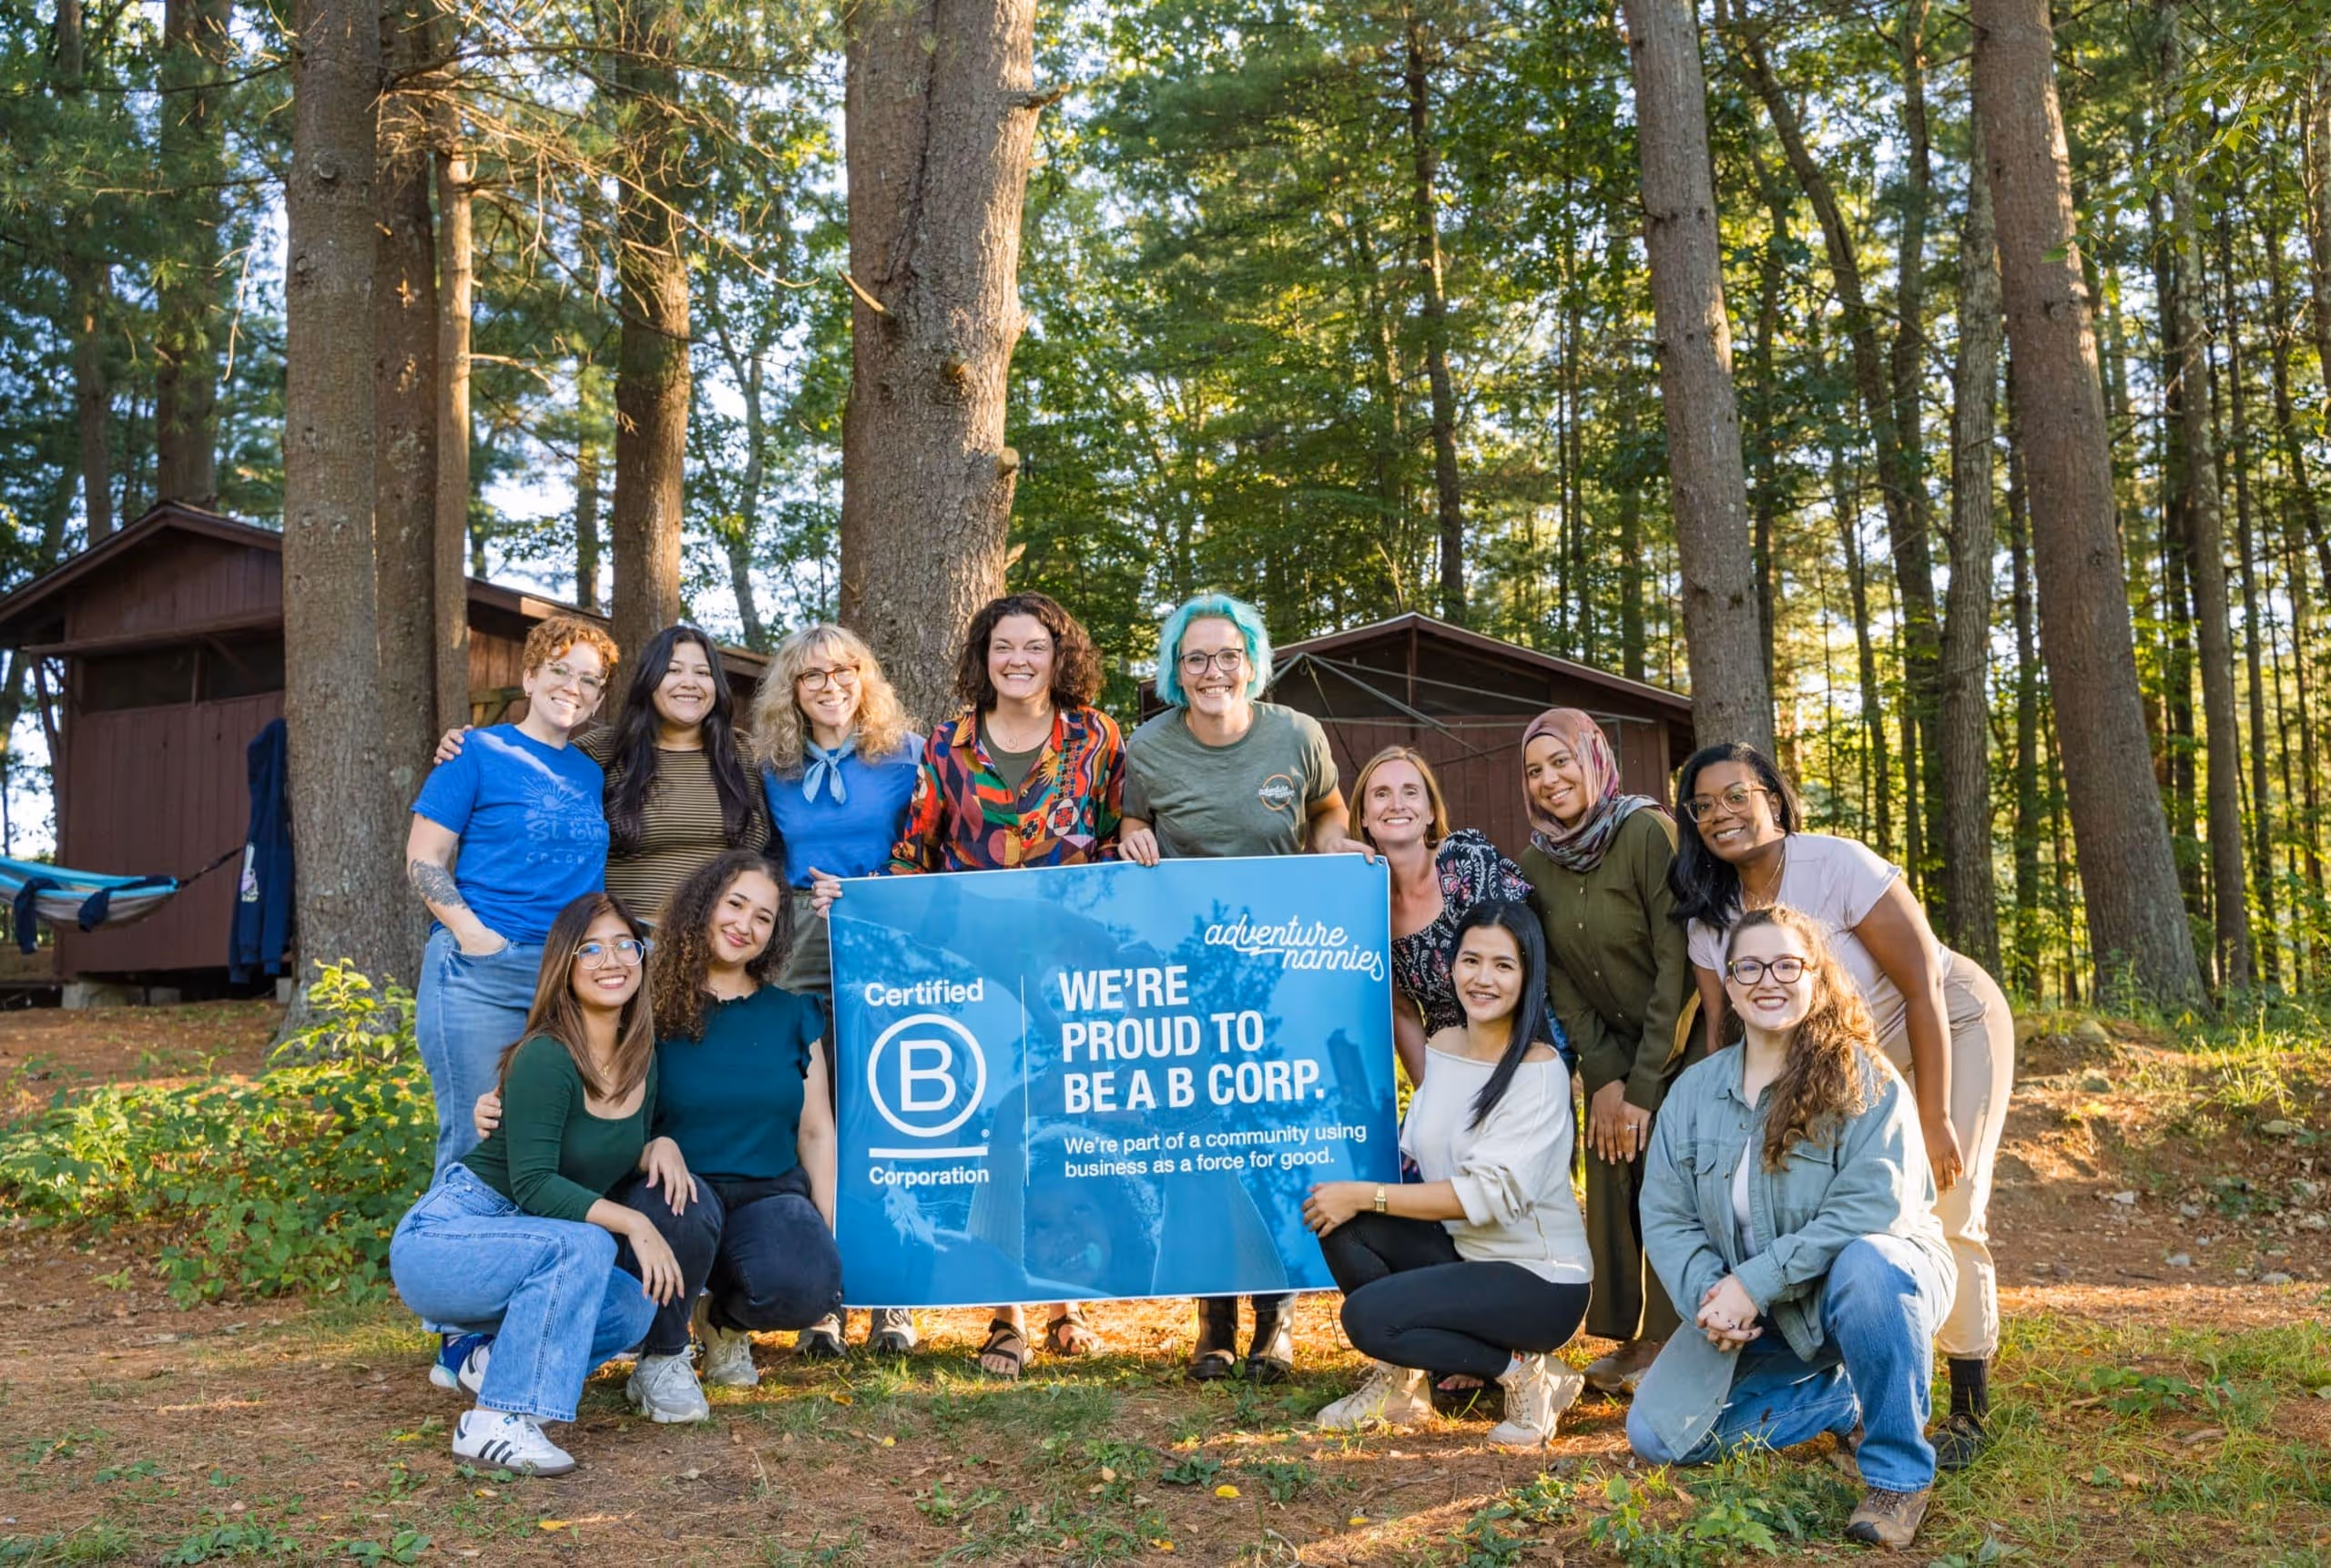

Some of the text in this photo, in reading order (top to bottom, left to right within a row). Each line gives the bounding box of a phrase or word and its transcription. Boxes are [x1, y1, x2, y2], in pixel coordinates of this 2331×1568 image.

[1205, 913, 1349, 957] adventure
[1282, 944, 1384, 982] nannies
[864, 977, 984, 1007] Certified
[1058, 965, 1189, 1012] WE'RE
[1062, 1010, 1264, 1063] PROUD TO
[900, 1039, 956, 1112] B
[1064, 1059, 1324, 1114] BE A B CORP.
[1064, 1124, 1367, 1156] We're part of a community using
[869, 1166, 989, 1188] Corporation
[1064, 1147, 1335, 1177] business as a force for good.
